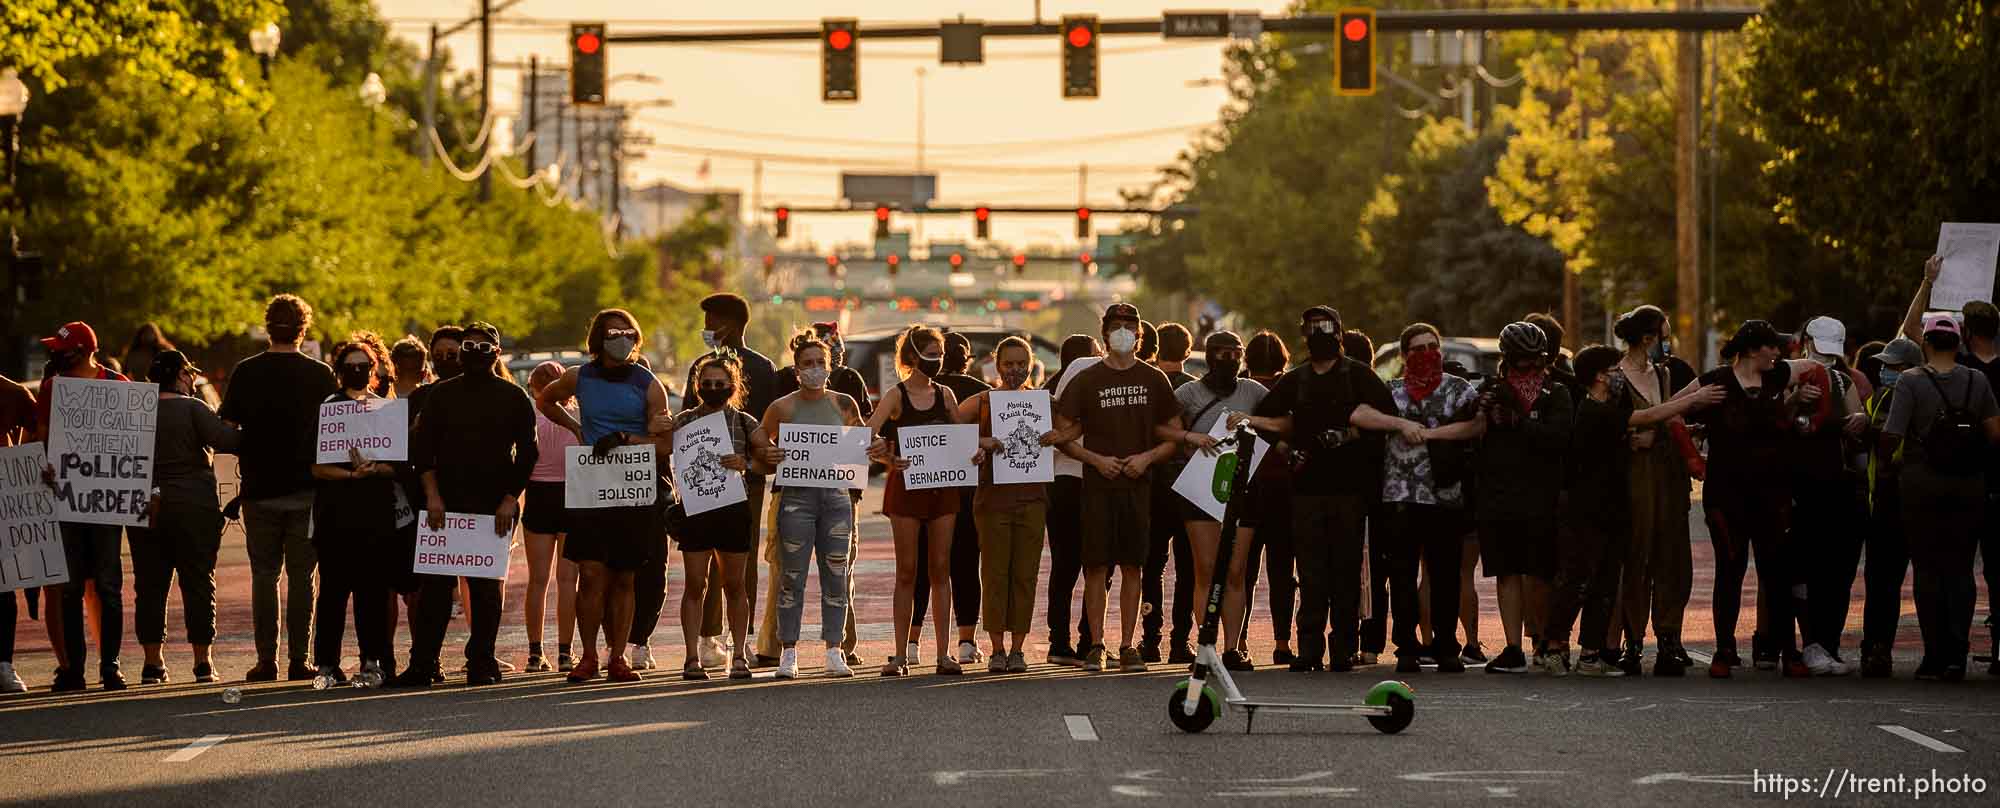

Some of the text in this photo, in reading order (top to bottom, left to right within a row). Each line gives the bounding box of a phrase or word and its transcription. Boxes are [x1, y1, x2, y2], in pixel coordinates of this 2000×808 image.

[58, 383, 157, 412] WHO DO
[1105, 385, 1144, 397] PROTECT
[321, 402, 372, 417] JUSTICE
[59, 408, 156, 432] YOU CALL
[320, 422, 346, 435] FOR
[65, 431, 138, 455] WHEN
[320, 436, 392, 452] BERNARDO
[783, 431, 838, 444] JUSTICE
[904, 434, 948, 449] JUSTICE
[577, 451, 650, 465] BERNARDO
[1008, 459, 1038, 473] Badges
[624, 469, 651, 481] FOR
[782, 467, 856, 481] BERNARDO
[909, 469, 967, 485] BERNARDO
[598, 486, 653, 501] JUSTICE
[697, 484, 726, 498] Badges
[420, 517, 476, 530] JTICE
[8, 518, 57, 548] DON'T
[419, 534, 447, 547] FOR
[418, 552, 494, 567] BERNARDO
